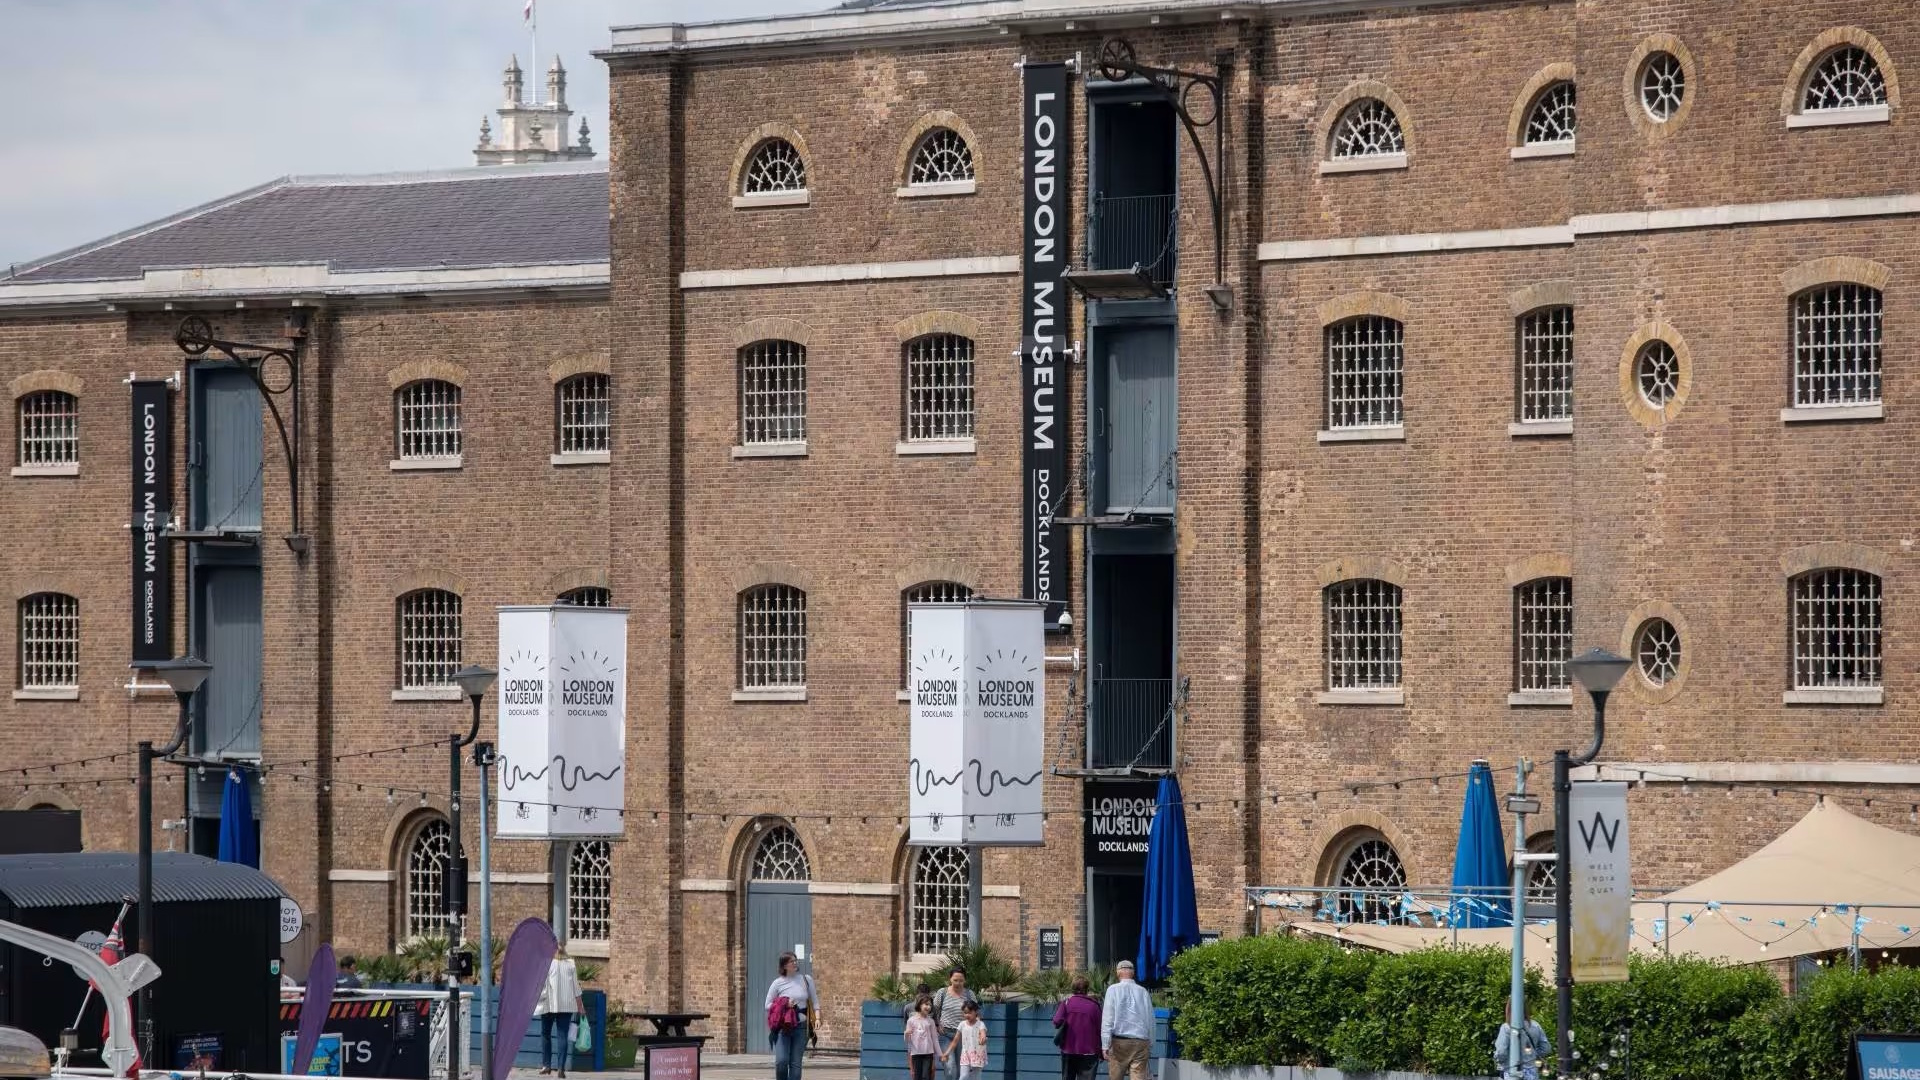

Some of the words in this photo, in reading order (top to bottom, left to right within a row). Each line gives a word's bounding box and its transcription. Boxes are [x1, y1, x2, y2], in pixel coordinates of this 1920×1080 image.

[1034, 93, 1056, 262] LONDON
[1032, 281, 1055, 450] MUSEUM
[143, 403, 155, 485] LONDON
[143, 492, 156, 572] MUSEUM
[1038, 469, 1050, 601] DOCKLANDS
[145, 580, 154, 644] DOCKLANDS
[505, 679, 543, 692] LONDON
[562, 680, 615, 693] LONDON
[917, 679, 957, 693] LONDON
[978, 680, 1034, 694] LONDON
[505, 692, 543, 705] MUSEUM
[562, 693, 614, 705] MUSEUM
[917, 693, 957, 706] MUSEUM
[978, 693, 1034, 707] MUSEUM
[567, 709, 608, 717] DOCKLANDS
[921, 710, 953, 718] DOCKLANDS
[983, 710, 1029, 719] DOCKLANDS
[1092, 797, 1157, 817] LONDON
[1092, 816, 1154, 836] MUSEUM
[1577, 811, 1620, 853] W
[1098, 841, 1149, 852] DOCKLANDS
[1589, 887, 1614, 895] QUAY
